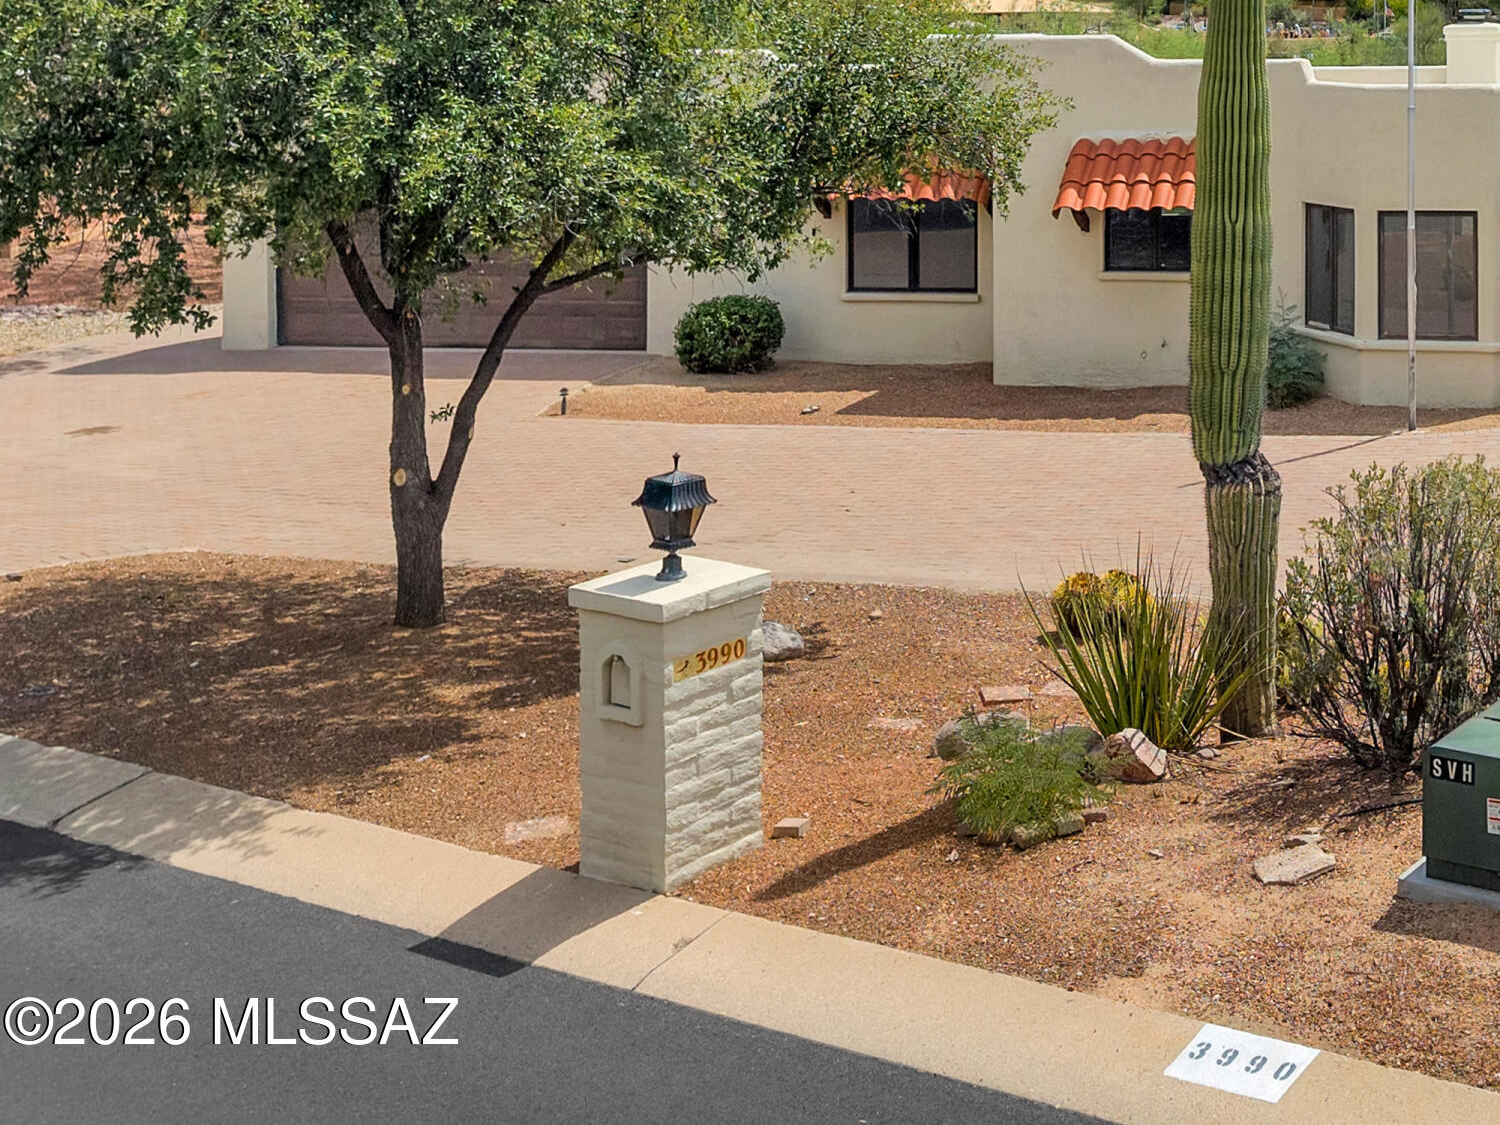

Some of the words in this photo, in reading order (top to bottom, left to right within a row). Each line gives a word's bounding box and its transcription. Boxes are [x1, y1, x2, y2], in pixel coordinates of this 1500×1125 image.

[696, 639, 744, 673] 3990
[1433, 759, 1472, 782] SVH
[1189, 1042, 1296, 1081] 3990
